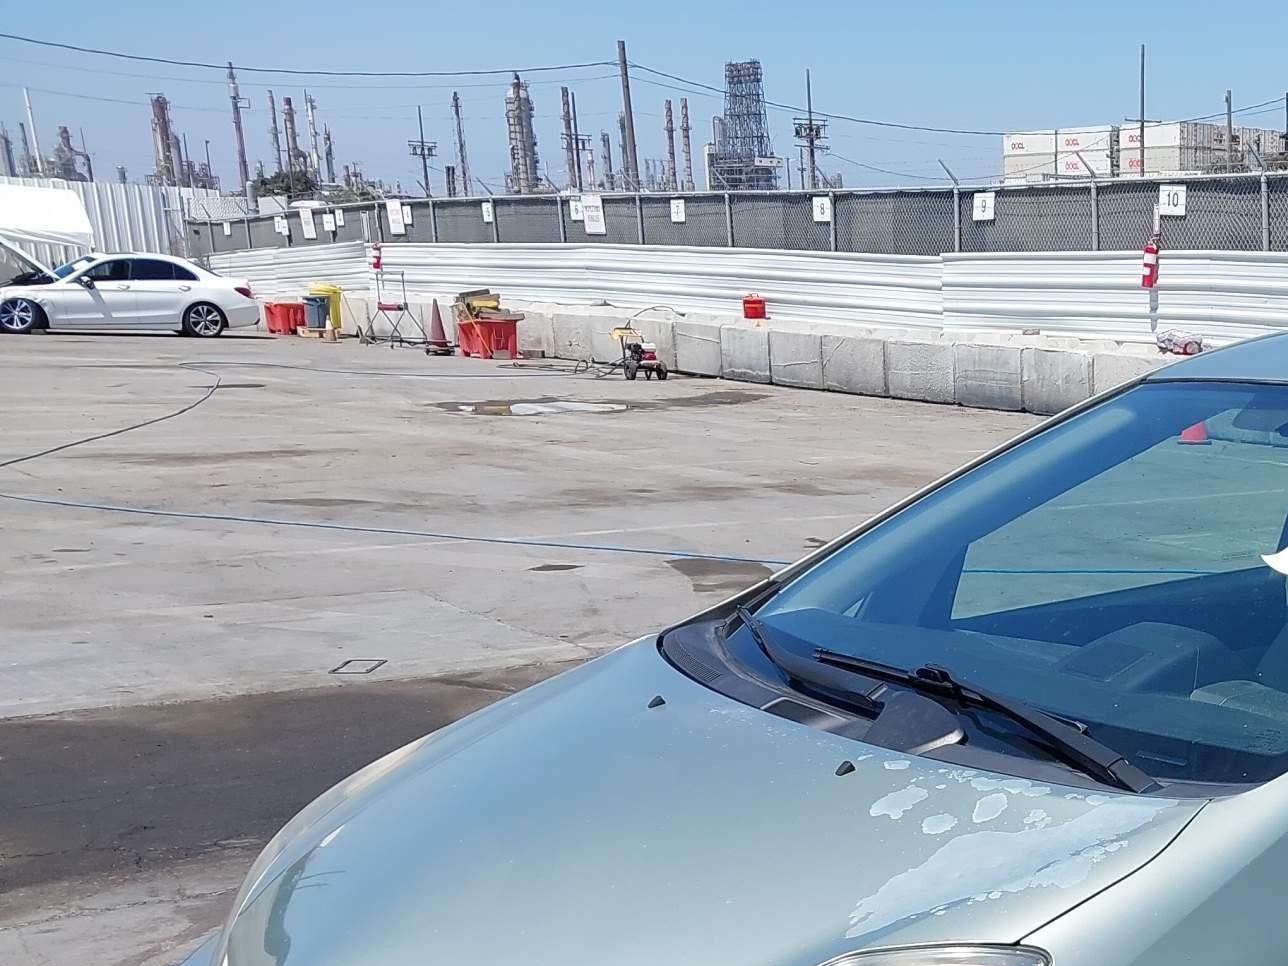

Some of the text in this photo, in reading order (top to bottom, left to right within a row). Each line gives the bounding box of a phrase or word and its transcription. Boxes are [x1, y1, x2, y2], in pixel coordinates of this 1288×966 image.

[980, 199, 987, 214] 9
[1167, 191, 1179, 207] 10
[819, 202, 826, 215] 8
